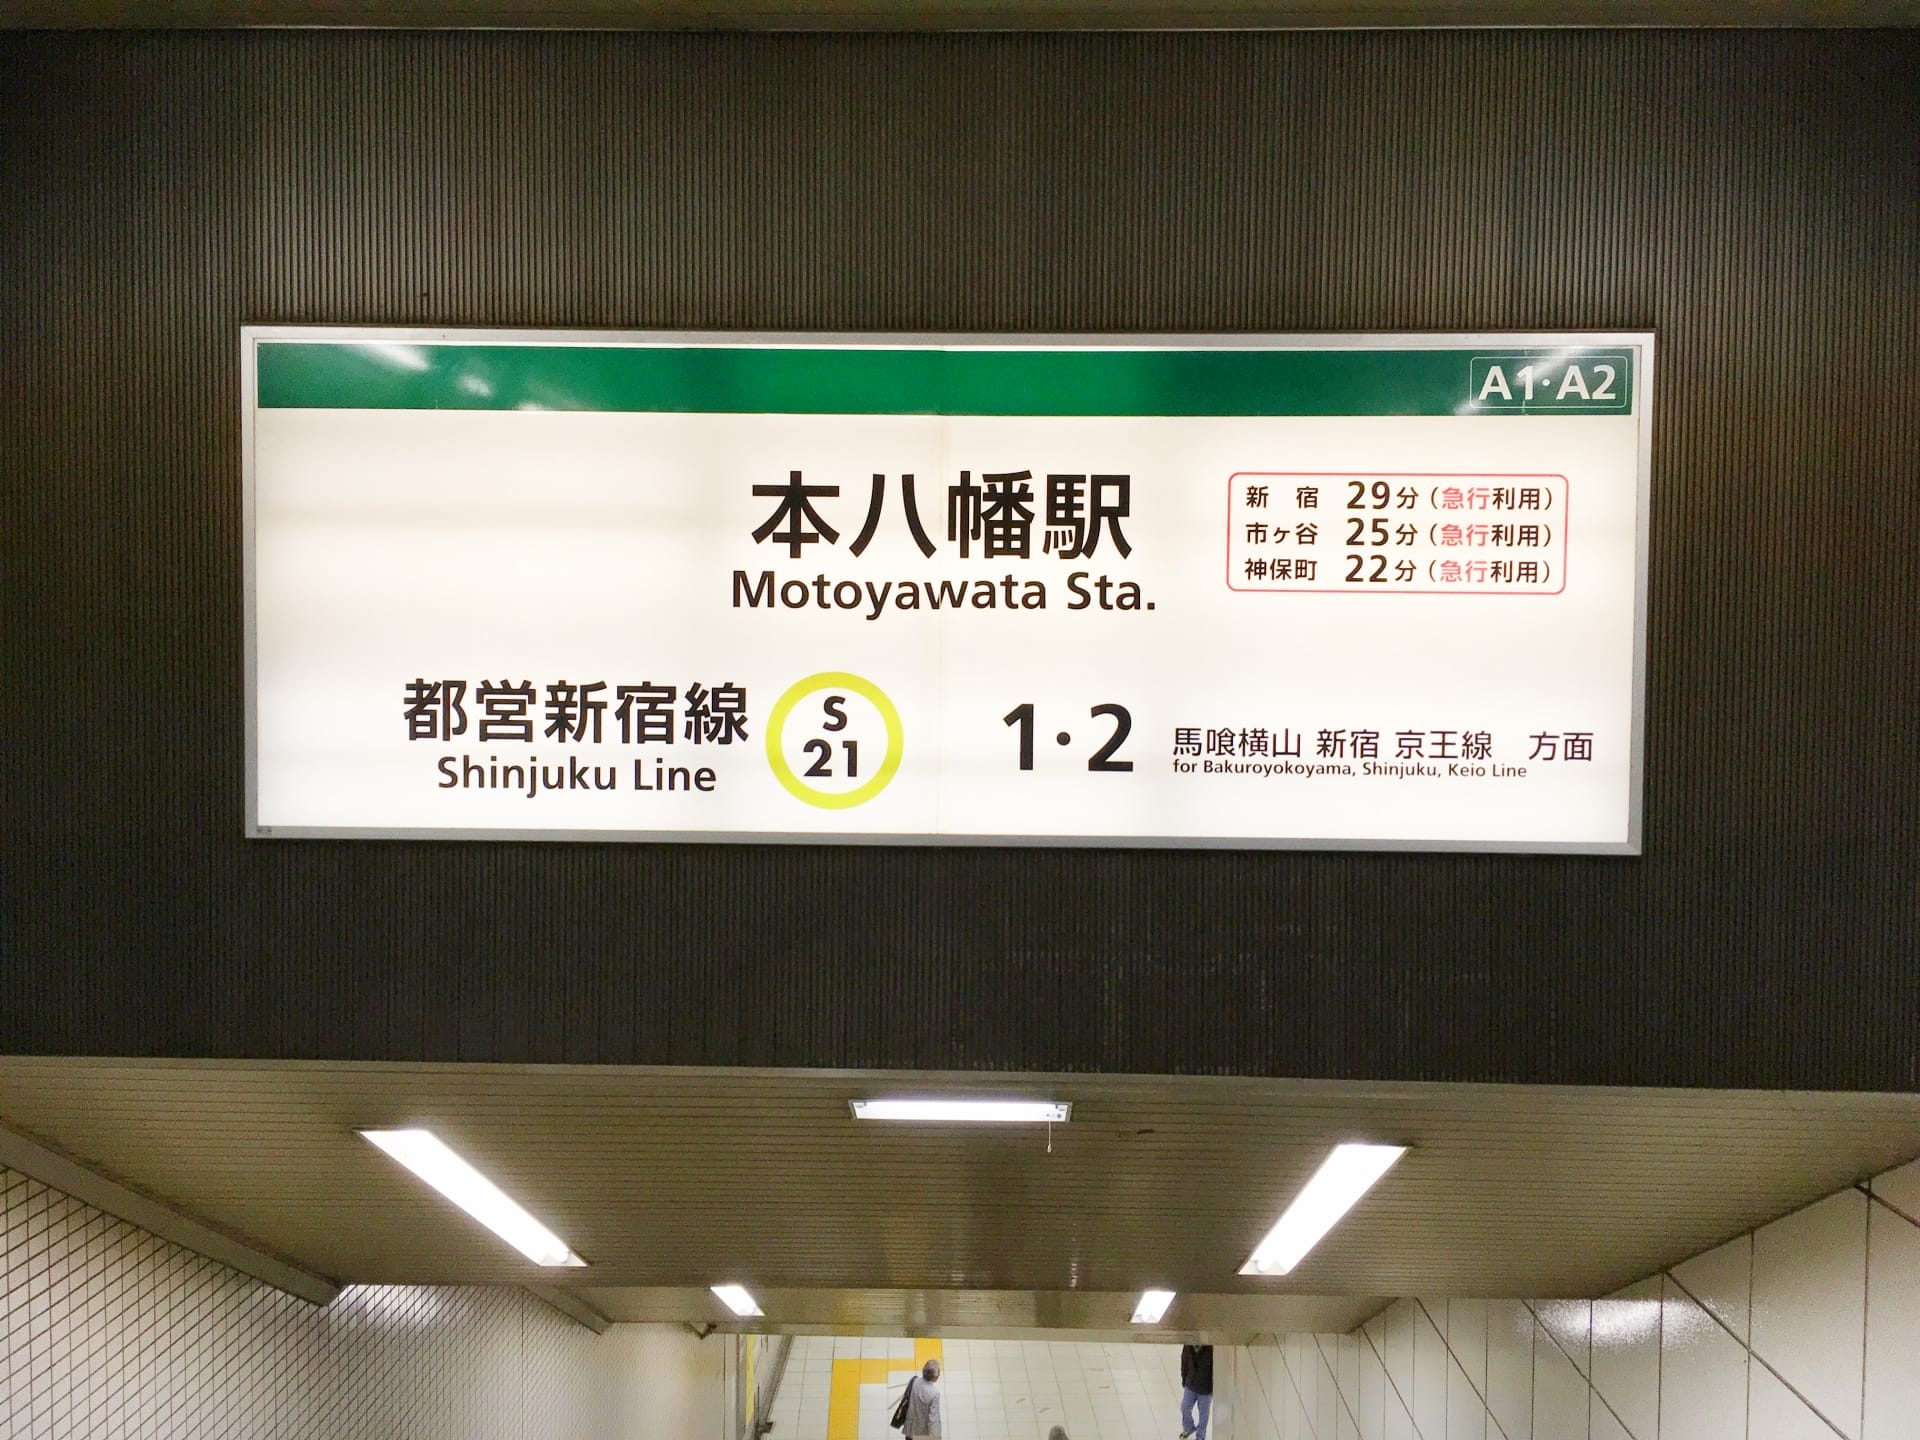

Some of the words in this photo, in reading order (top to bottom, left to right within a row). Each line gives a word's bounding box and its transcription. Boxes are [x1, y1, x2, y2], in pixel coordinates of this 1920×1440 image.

[751, 470, 1132, 559] 本八幡駅
[1245, 558, 1317, 581] 神保町
[733, 570, 1046, 621] Motoyawata
[1067, 572, 1155, 610] Sta.
[404, 678, 749, 744] 都営新宿線
[823, 696, 847, 732] S
[803, 740, 858, 777] 21
[1173, 728, 1300, 757] 馬喰横山
[1317, 729, 1379, 758] 新宿
[1395, 730, 1492, 759] 京王線
[1529, 731, 1593, 761] 方面
[438, 755, 616, 798] Shinjuku
[635, 758, 716, 791] Line
[1173, 759, 1198, 773] for
[1204, 760, 1355, 778] Bakuroyokoyama,
[1363, 762, 1440, 779] Shinjuku,
[1449, 763, 1485, 776] Keio
[1493, 764, 1526, 777] Line
